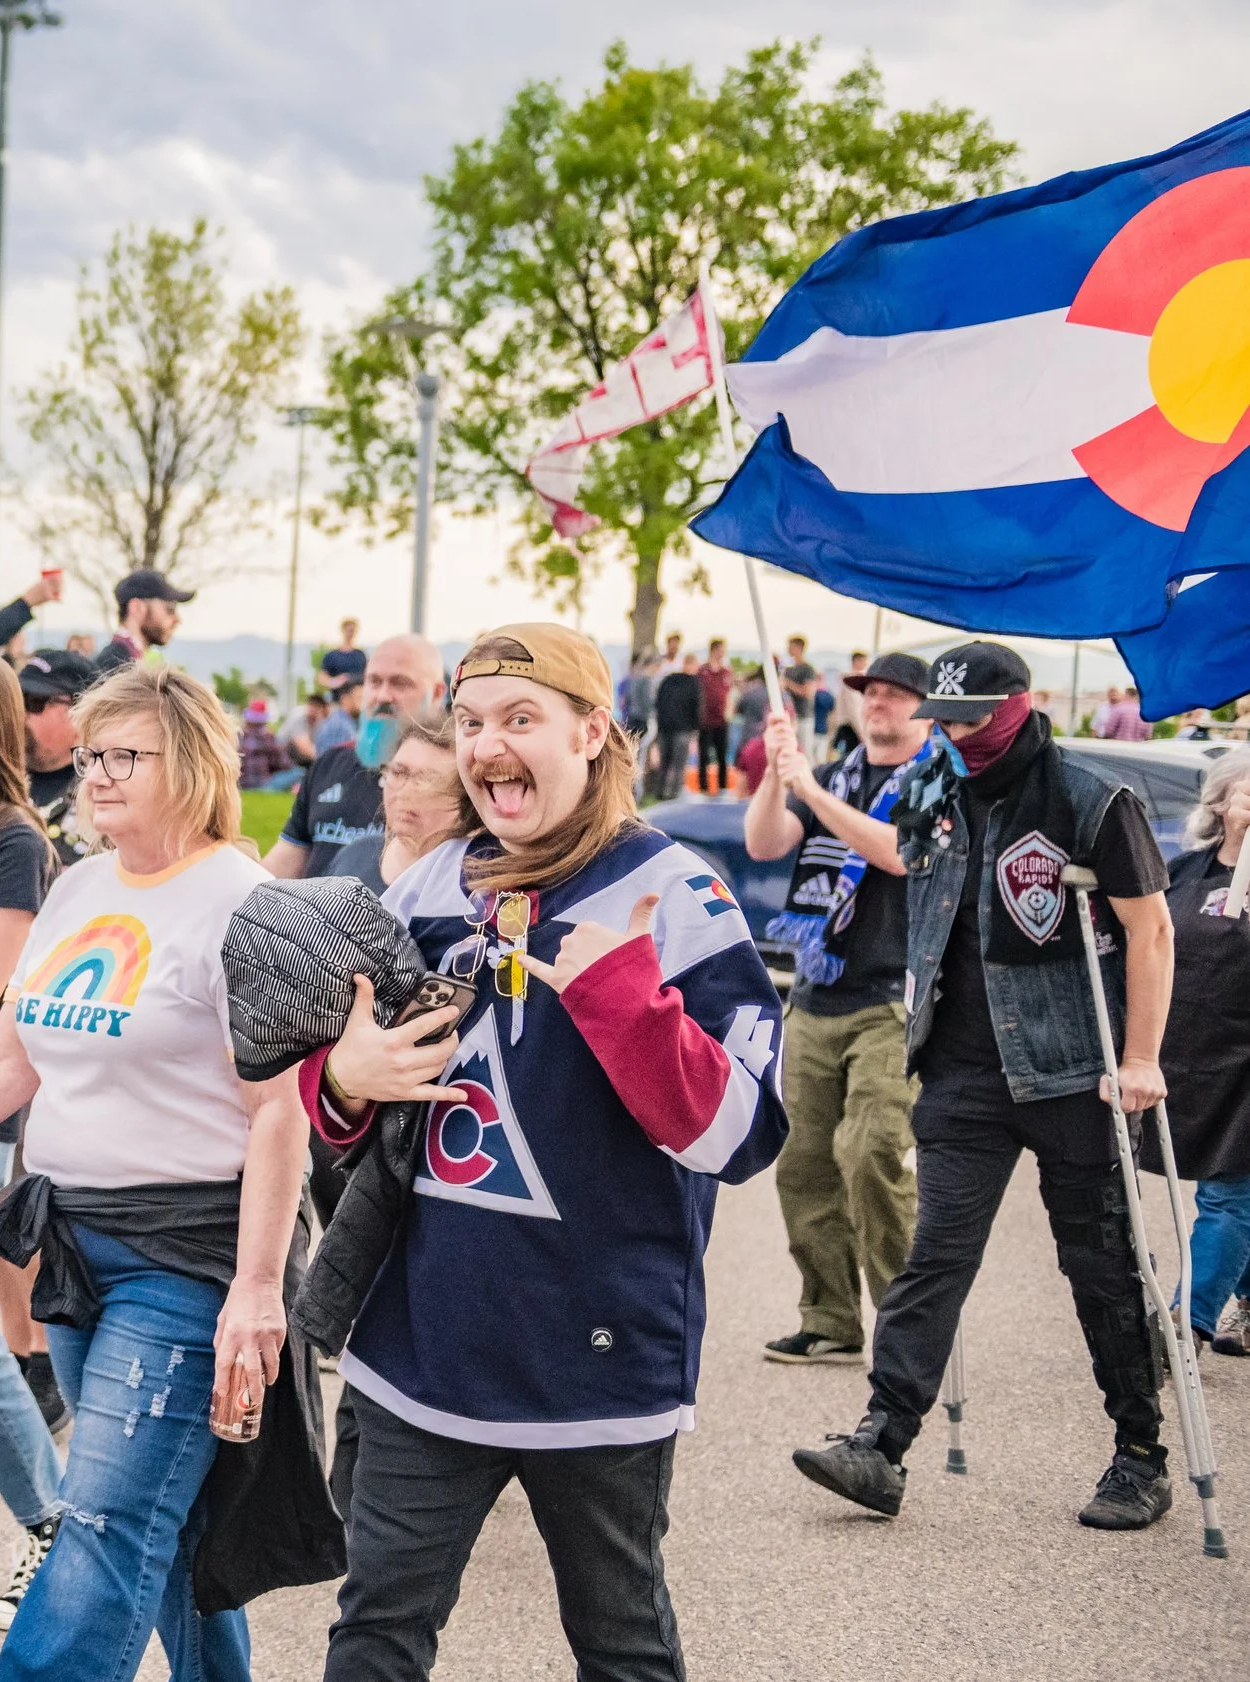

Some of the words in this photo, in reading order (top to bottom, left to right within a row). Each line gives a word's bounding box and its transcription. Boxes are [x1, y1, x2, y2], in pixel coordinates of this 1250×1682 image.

[1012, 856, 1060, 877] COLORADO
[1018, 873, 1054, 885] RAPIDS
[16, 997, 41, 1025] BE
[42, 1003, 132, 1037] HIPPY
